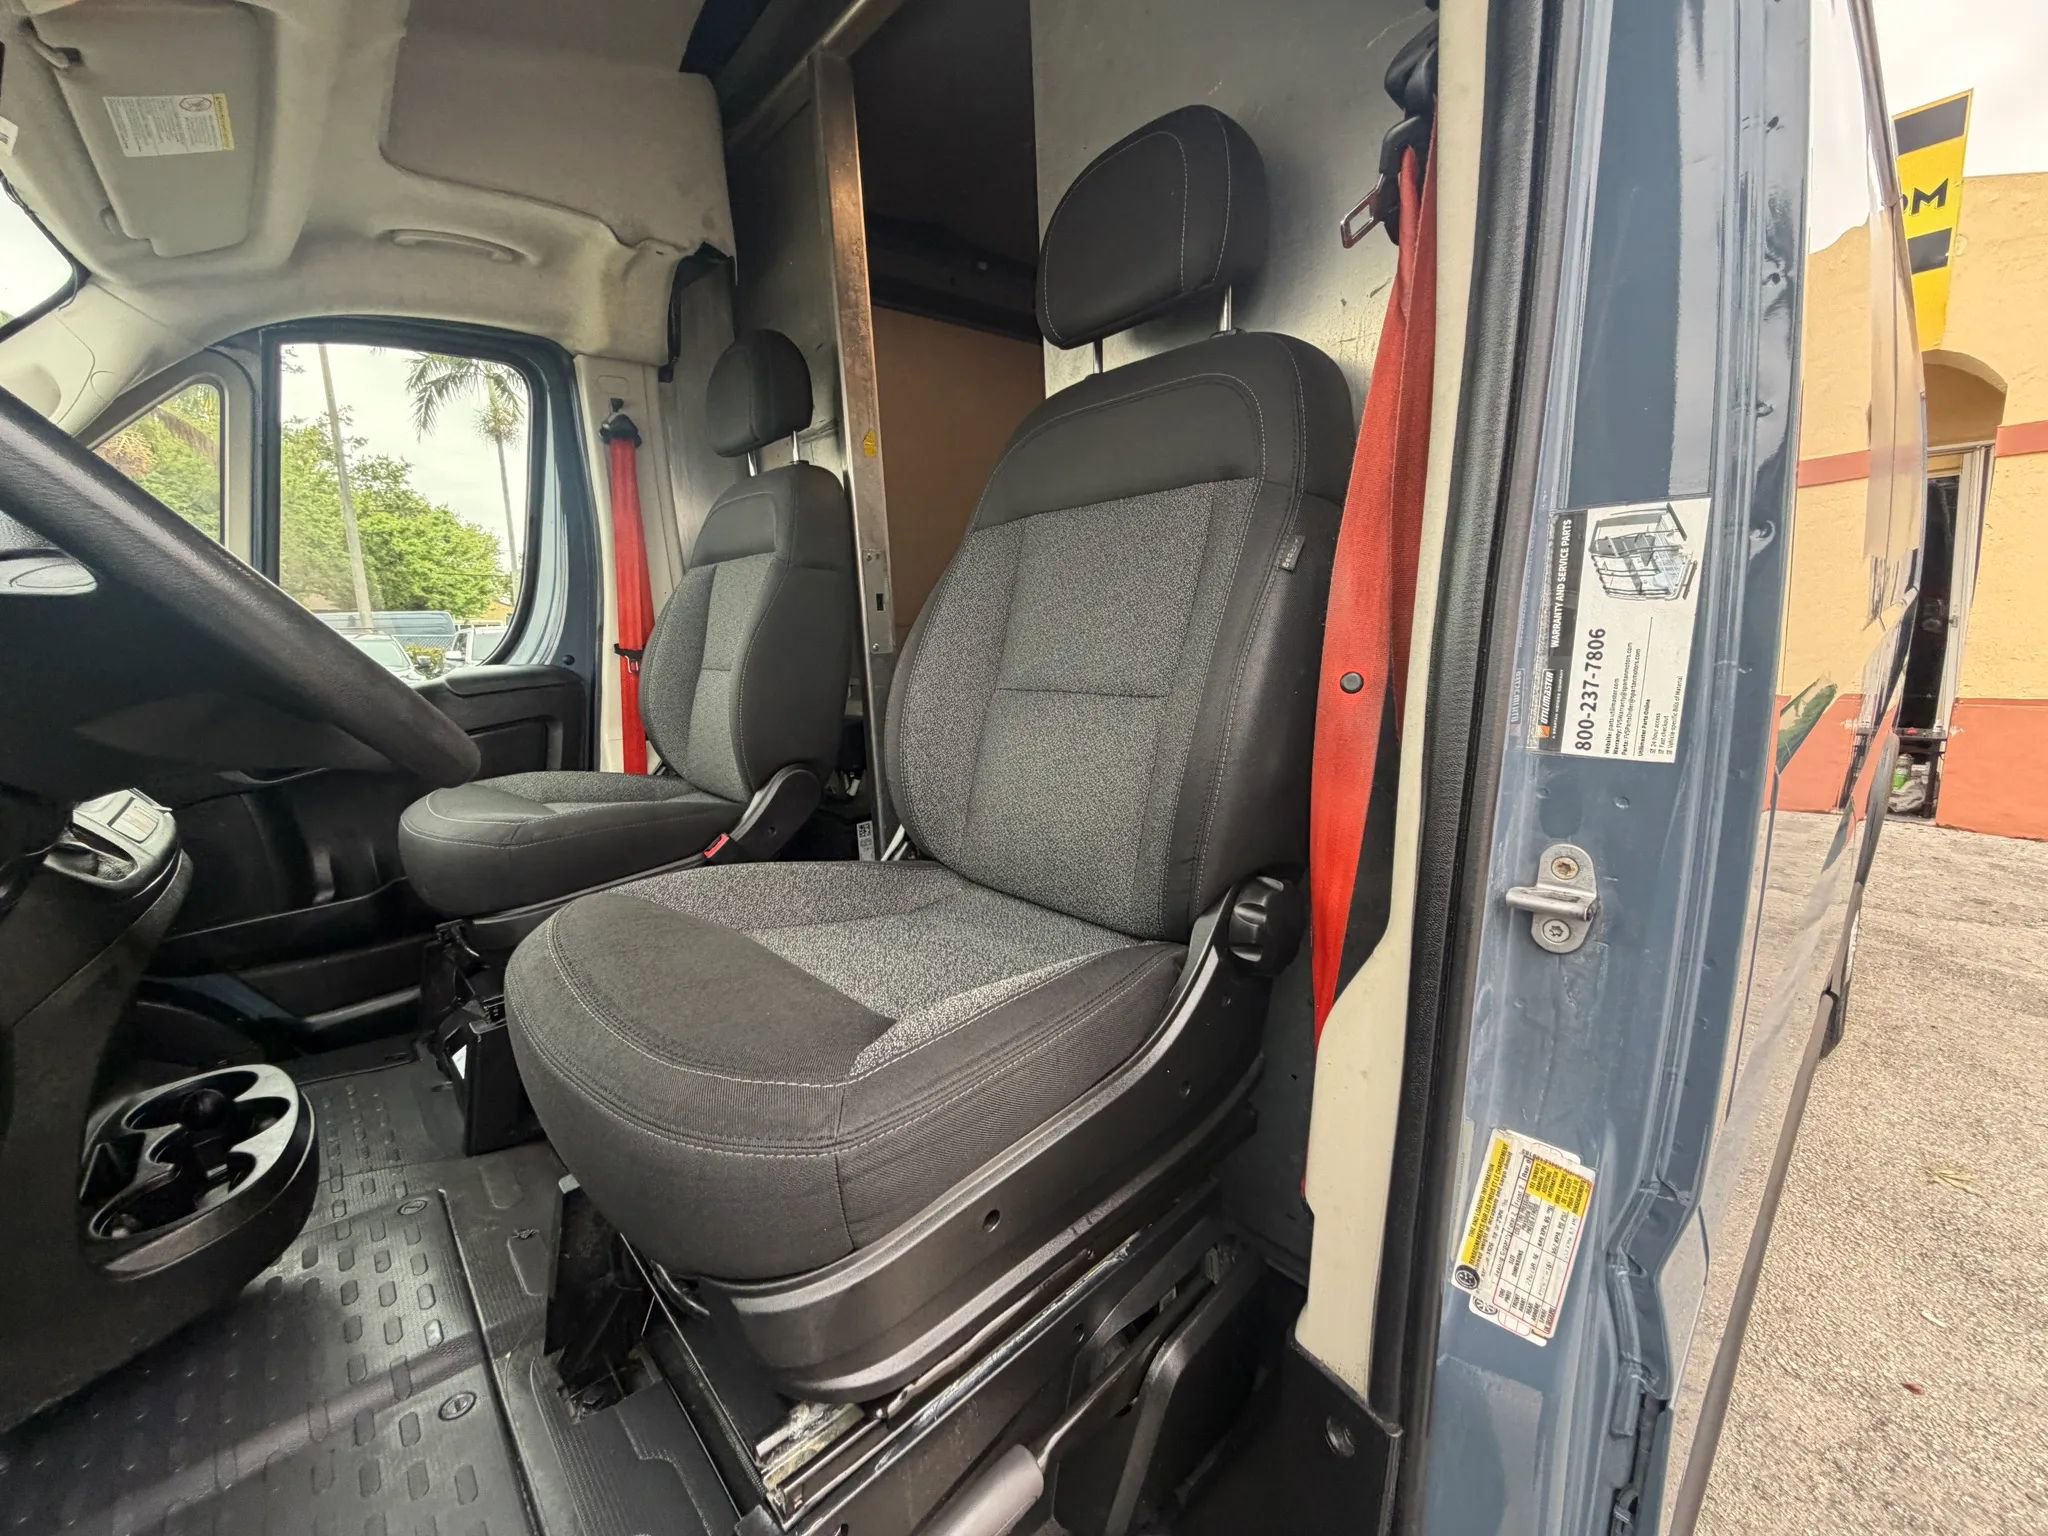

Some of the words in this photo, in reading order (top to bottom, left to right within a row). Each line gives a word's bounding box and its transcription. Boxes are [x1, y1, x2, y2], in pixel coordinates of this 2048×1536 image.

[1560, 519, 1572, 546] PARTS
[1556, 547, 1569, 581] SERVICE
[1554, 583, 1565, 601] AND
[1549, 601, 1564, 647] WARRANTY
[1540, 670, 1553, 723] UTILIMASTER
[1574, 628, 1605, 751] 800-237-7806
